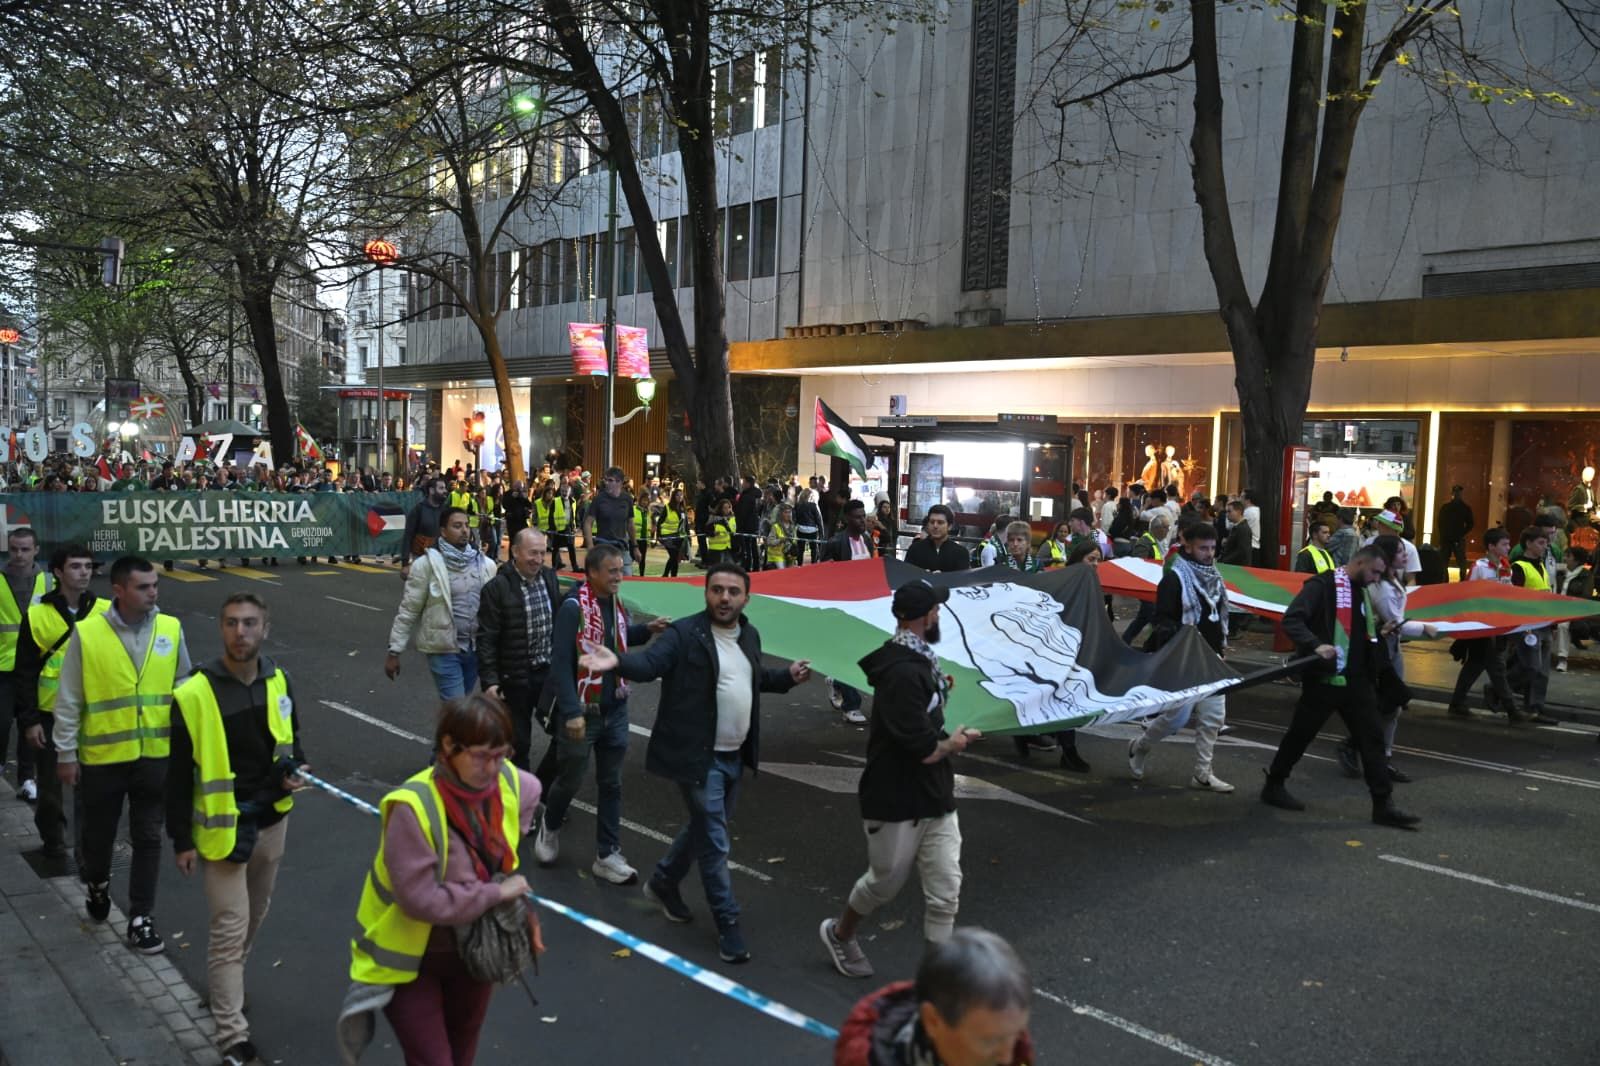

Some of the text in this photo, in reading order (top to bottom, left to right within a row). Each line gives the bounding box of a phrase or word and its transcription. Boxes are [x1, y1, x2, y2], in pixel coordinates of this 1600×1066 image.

[102, 499, 317, 525] EUSKAL HERRIA
[94, 529, 119, 541] HERRI
[138, 526, 290, 552] PALESTINA
[303, 537, 323, 548] STOP!
